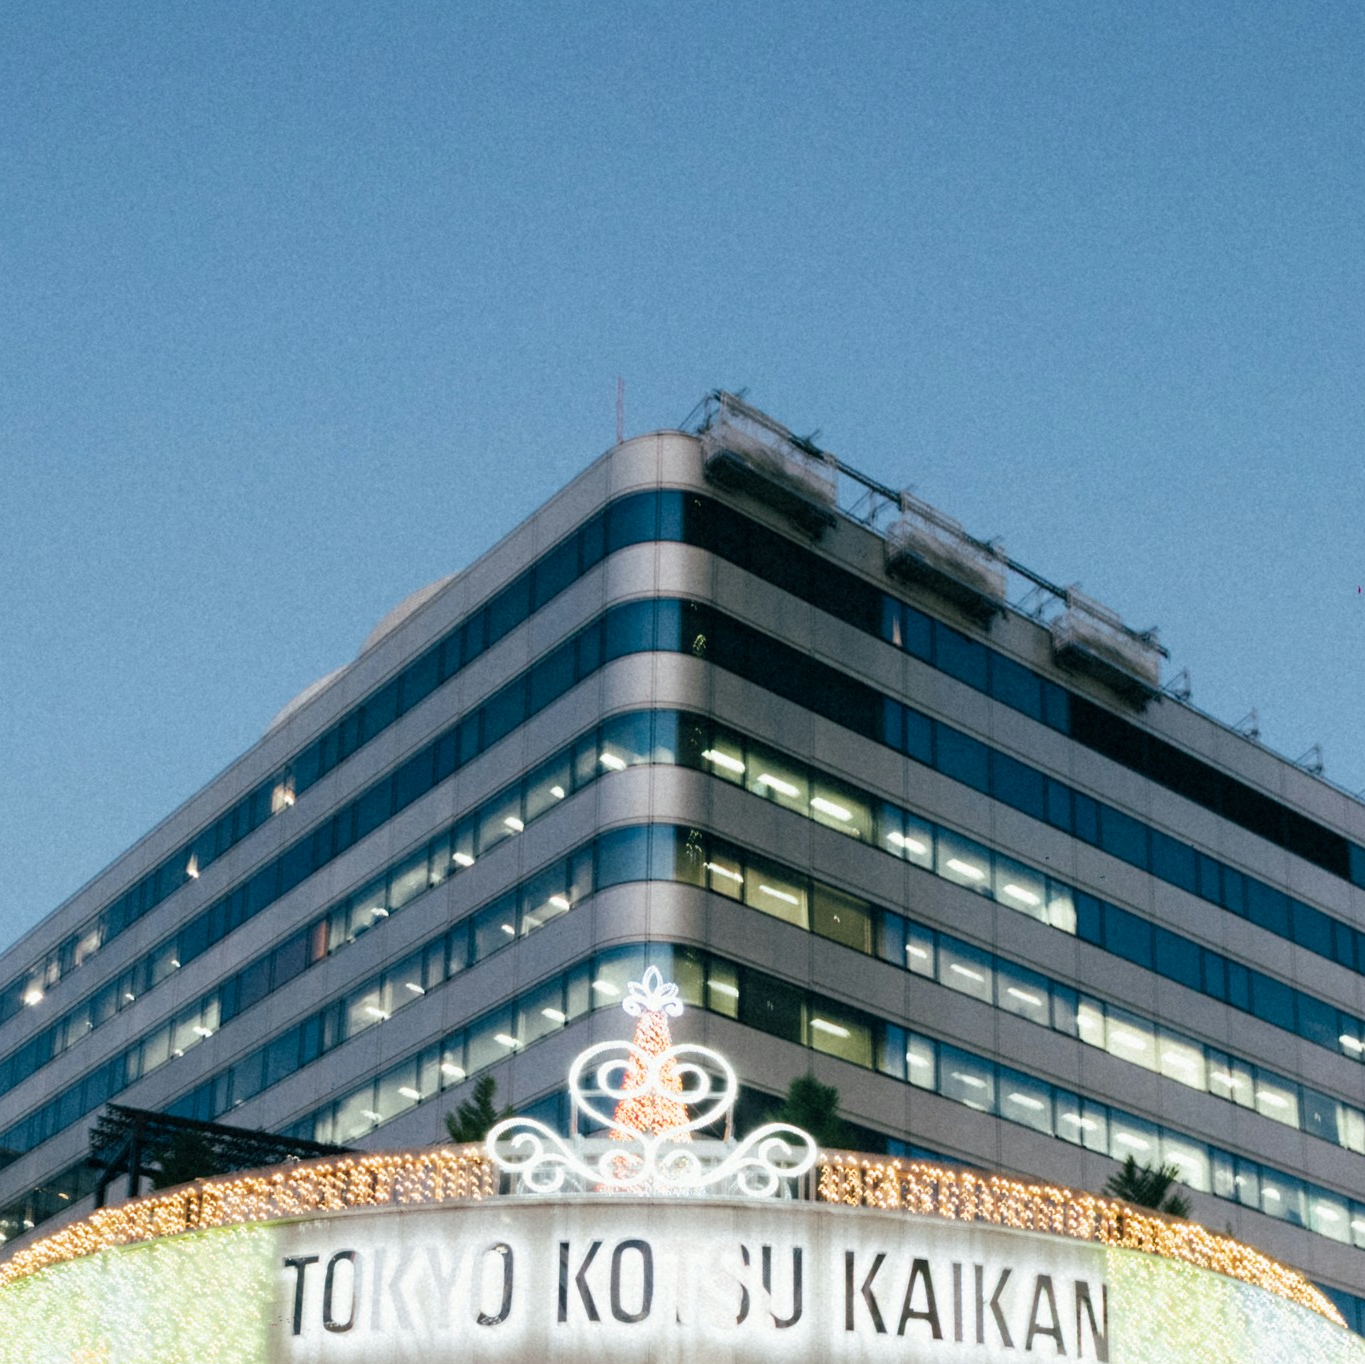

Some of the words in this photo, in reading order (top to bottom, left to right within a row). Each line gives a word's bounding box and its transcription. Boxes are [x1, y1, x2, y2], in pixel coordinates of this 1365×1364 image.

[284, 1242, 514, 1336] TOKYO
[557, 1239, 803, 1329] KOSU
[844, 1250, 1109, 1364] KAIKAN
